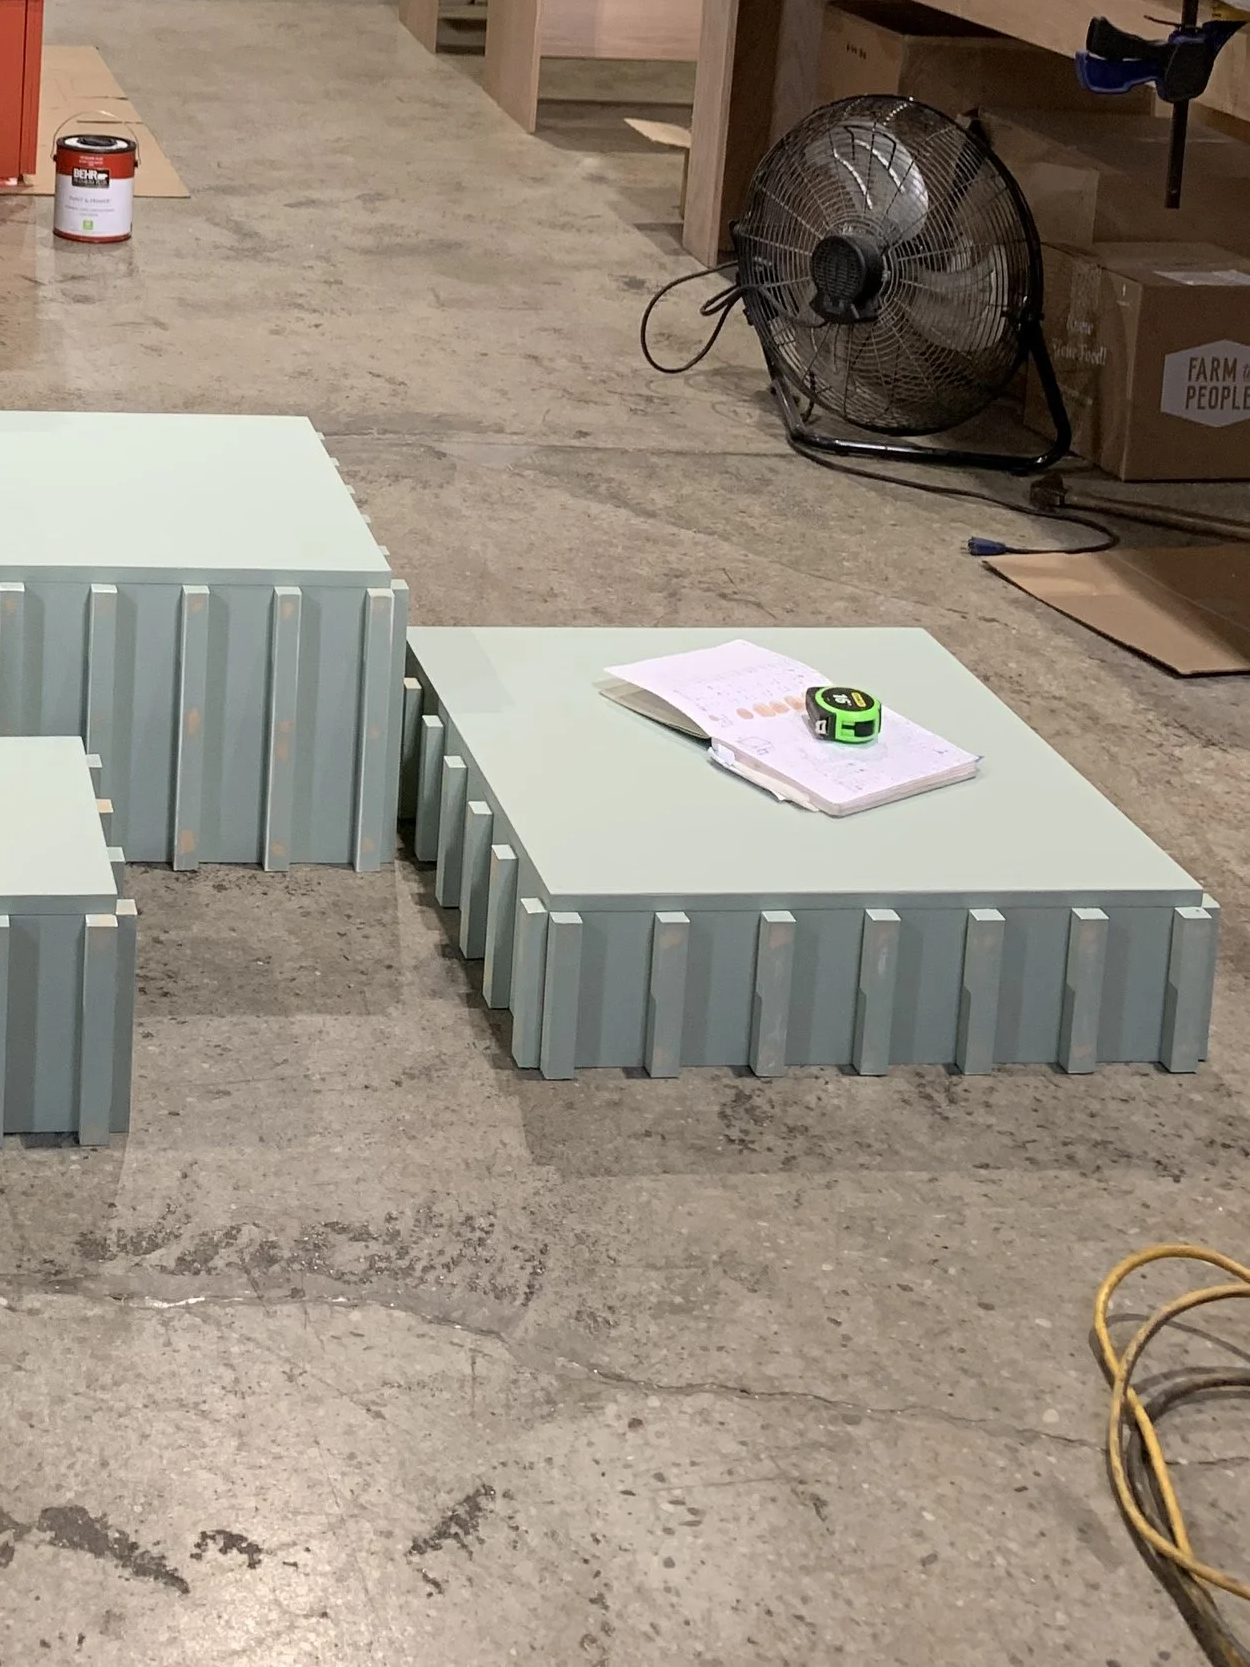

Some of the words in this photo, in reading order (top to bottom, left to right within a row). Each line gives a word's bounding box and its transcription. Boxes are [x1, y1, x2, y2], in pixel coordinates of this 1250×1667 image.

[73, 167, 98, 181] BEHR
[1188, 356, 1238, 383] FARM
[1184, 385, 1250, 411] PEOPLE
